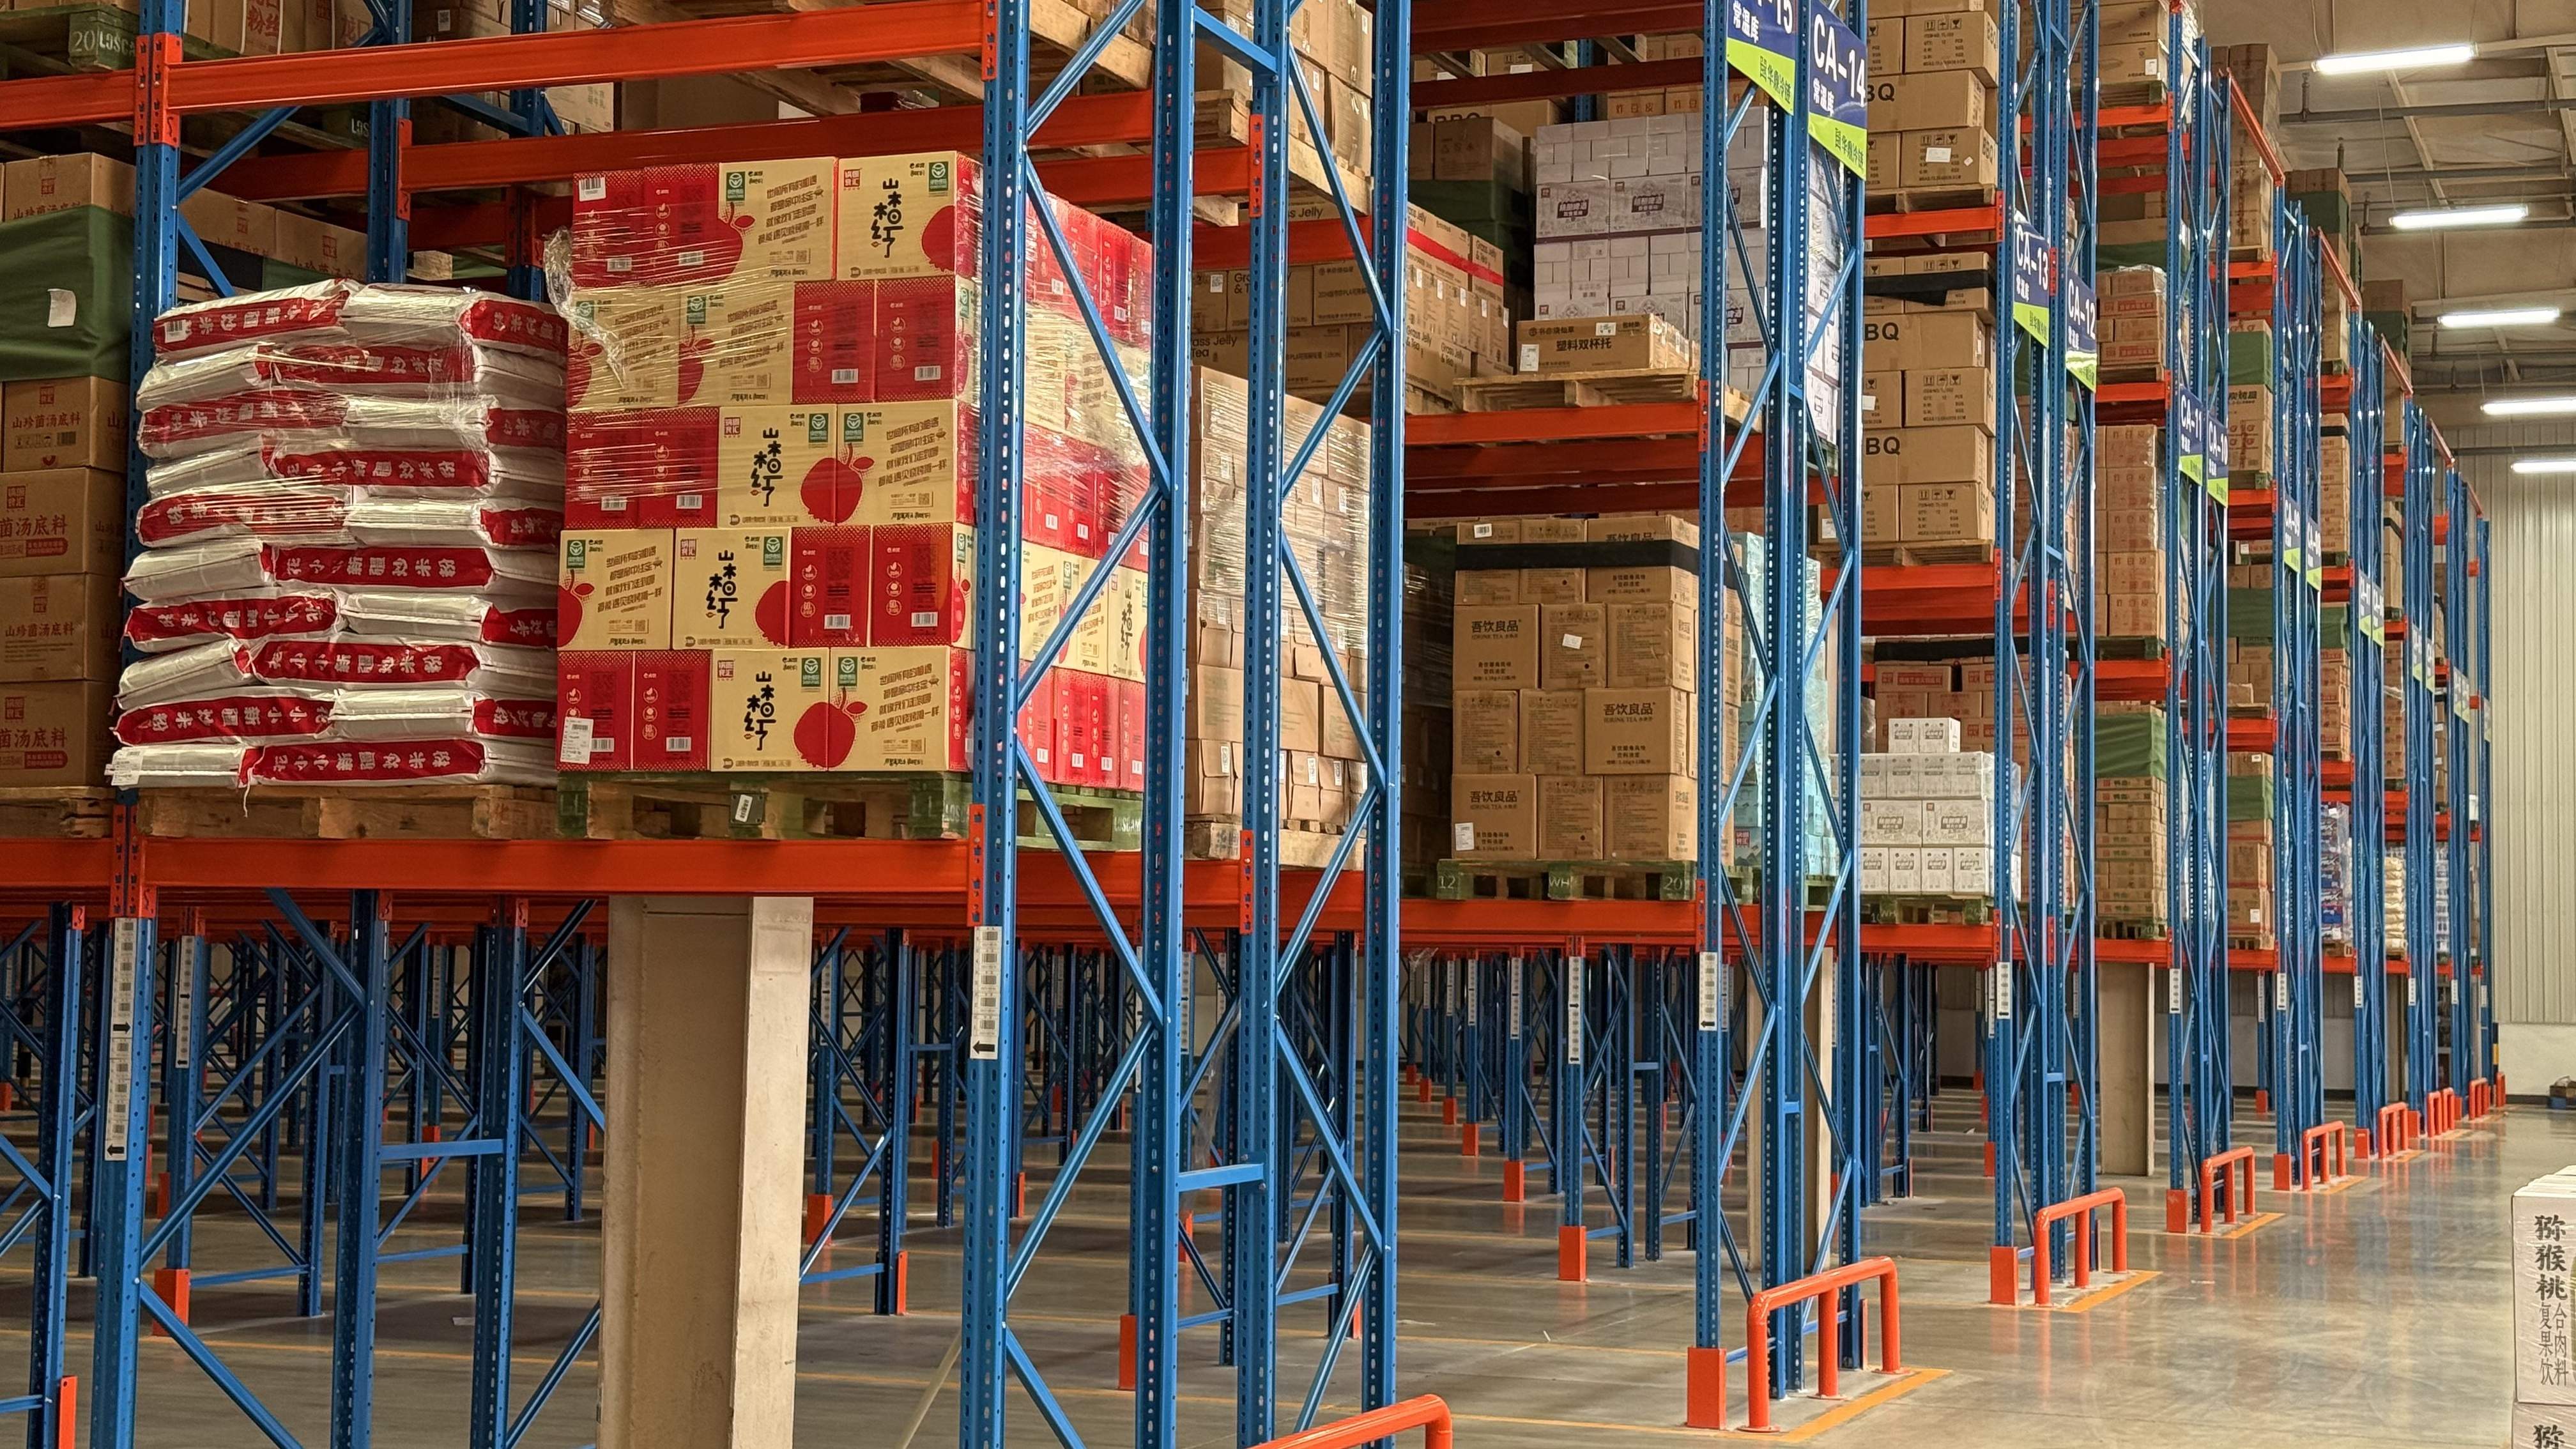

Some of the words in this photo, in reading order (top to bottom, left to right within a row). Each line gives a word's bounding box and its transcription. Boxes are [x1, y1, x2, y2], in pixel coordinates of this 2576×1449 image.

[247, 5, 280, 38] 粉丝
[1733, 0, 1759, 43] 常温库
[73, 31, 94, 51] 20
[1987, 21, 1997, 50] BBQ
[1814, 14, 1866, 107] CA-14
[1813, 77, 1834, 116] 常温库
[1982, 136, 1993, 164] BBQ
[871, 178, 904, 258] 山楂红了
[1298, 206, 1324, 219] Jelly
[1476, 240, 1487, 254] Grass
[1488, 245, 1497, 259] Jelly
[2017, 225, 2048, 291] CA-13
[1234, 284, 1243, 294] &
[2068, 279, 2096, 340] CA-12
[1213, 335, 1238, 348] Jelly
[1407, 326, 1419, 339] Grass
[1420, 331, 1432, 347] Jelly
[1412, 341, 1421, 351] Tea
[1556, 337, 1613, 352] 塑料双杯托
[1441, 342, 1453, 355] Grass
[1453, 347, 1464, 362] Jelly
[12, 411, 81, 429] 山珍菌汤底料
[2181, 394, 2202, 442] CA-11
[2209, 420, 2228, 466] CA-10
[287, 459, 456, 479] 花小小新疆炒米粉
[750, 427, 783, 507] 山楂红了
[288, 556, 456, 578] 花小小新疆炒米粉
[706, 550, 738, 629] 山楂红了
[5, 622, 74, 638] 山珍菌汤底料
[1472, 620, 1519, 633] 吾饮良品
[268, 650, 443, 674] 花小小新疆炒米粉
[744, 671, 776, 751] 山楂红了
[1604, 703, 1653, 716] 吾饮良品
[273, 749, 452, 771] 花小小新疆炒米粉
[1470, 790, 1517, 803] 吾饮良品
[1439, 875, 1455, 889] 12
[2534, 1215, 2568, 1301] 猕猴桃
